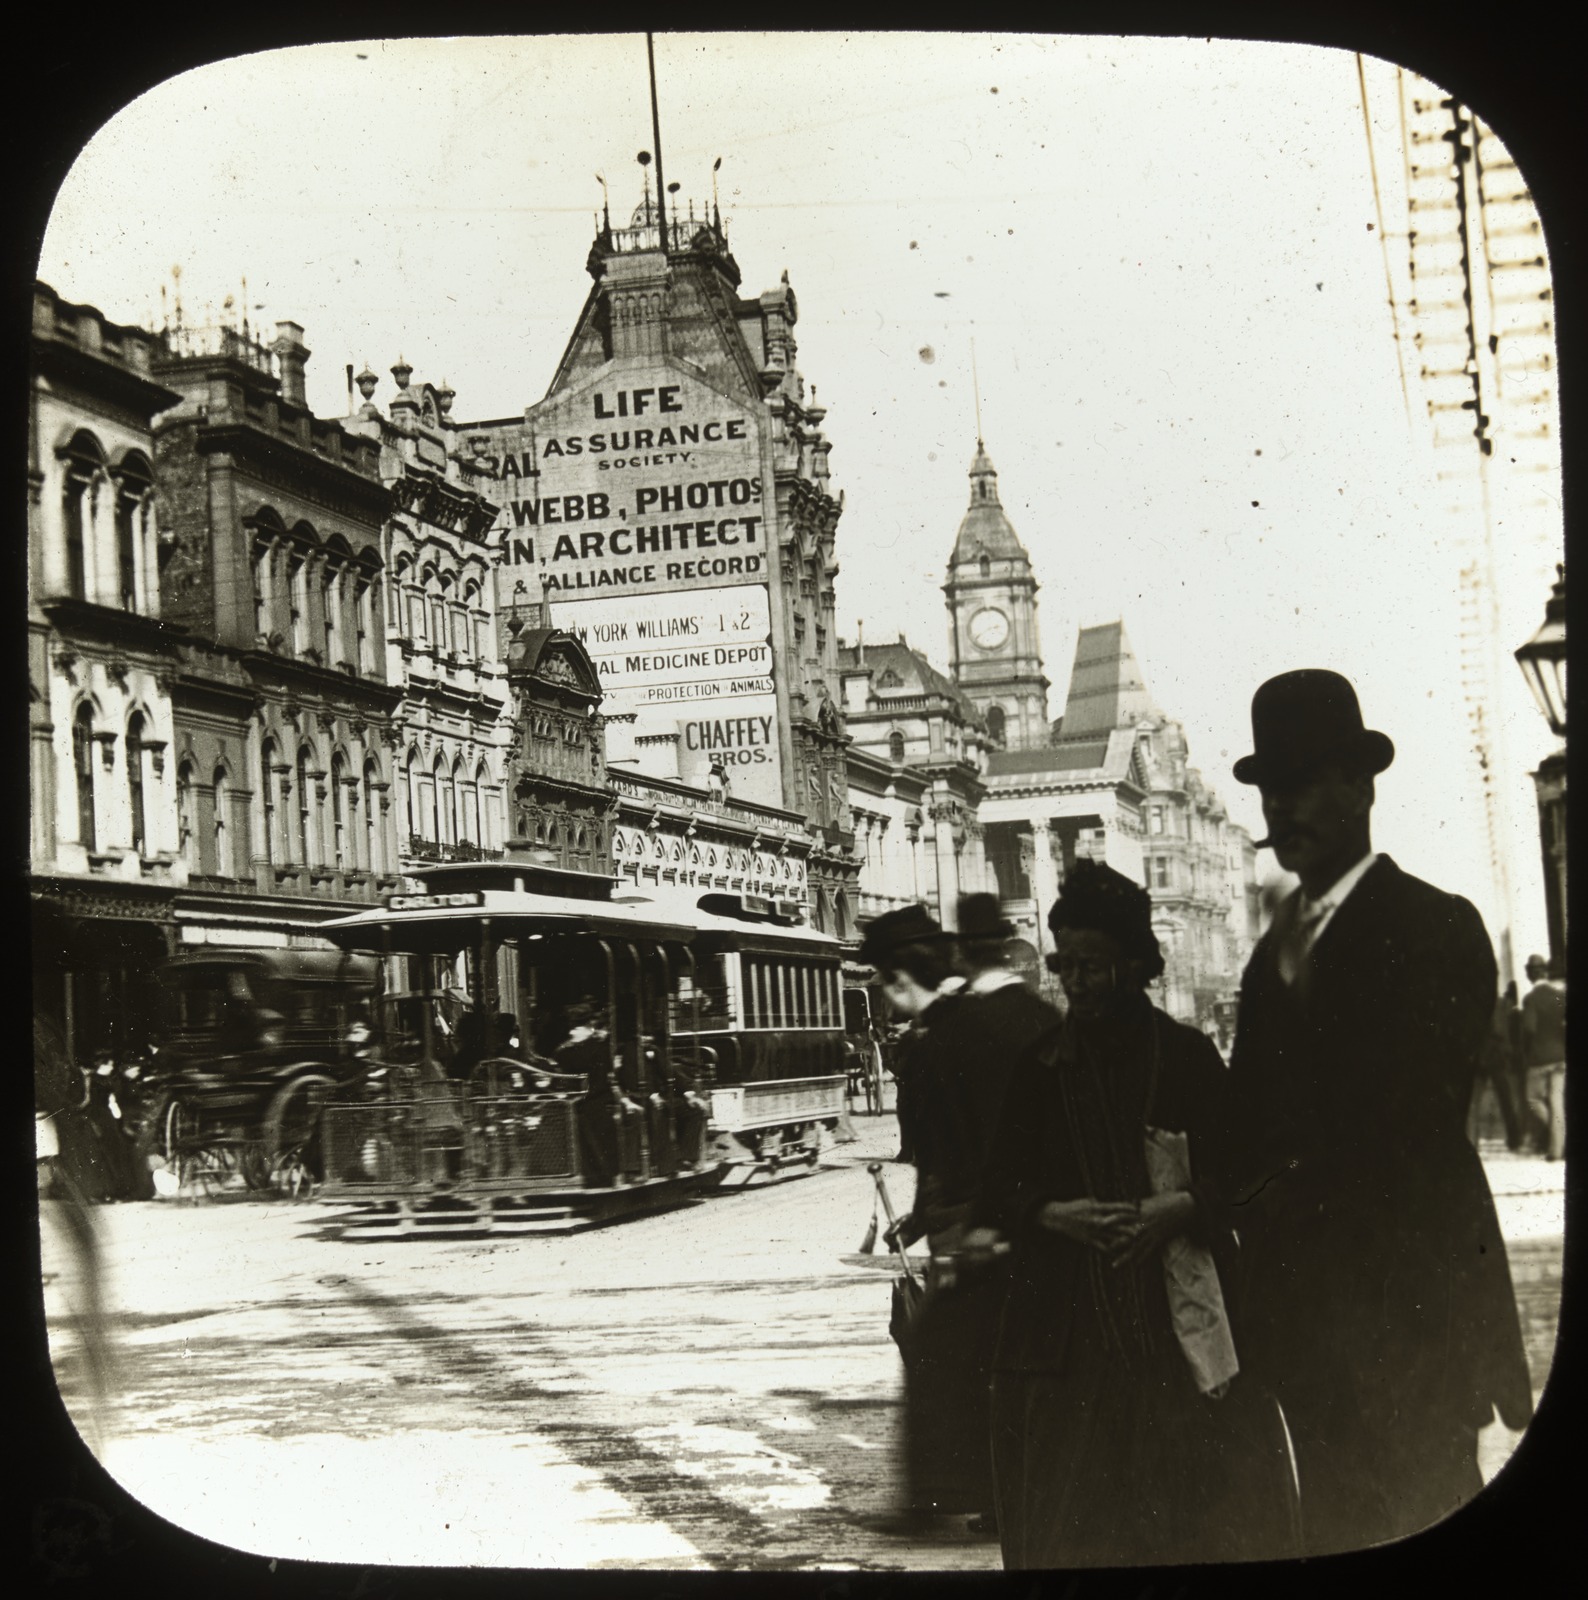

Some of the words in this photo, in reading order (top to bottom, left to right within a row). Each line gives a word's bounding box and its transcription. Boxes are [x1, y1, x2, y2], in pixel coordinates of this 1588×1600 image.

[594, 385, 683, 419] LIFE
[543, 419, 747, 458] ASSURANCE
[552, 516, 762, 562] ARCHITECT
[513, 580, 528, 595] &
[593, 622, 628, 643] YORK
[626, 652, 711, 673] MEDICINE
[715, 647, 767, 665] DEPOT
[648, 683, 720, 700] PROTECTION
[730, 679, 773, 693] ANIMALS
[685, 716, 772, 751] CHAFFEY
[709, 748, 773, 767] BROS.
